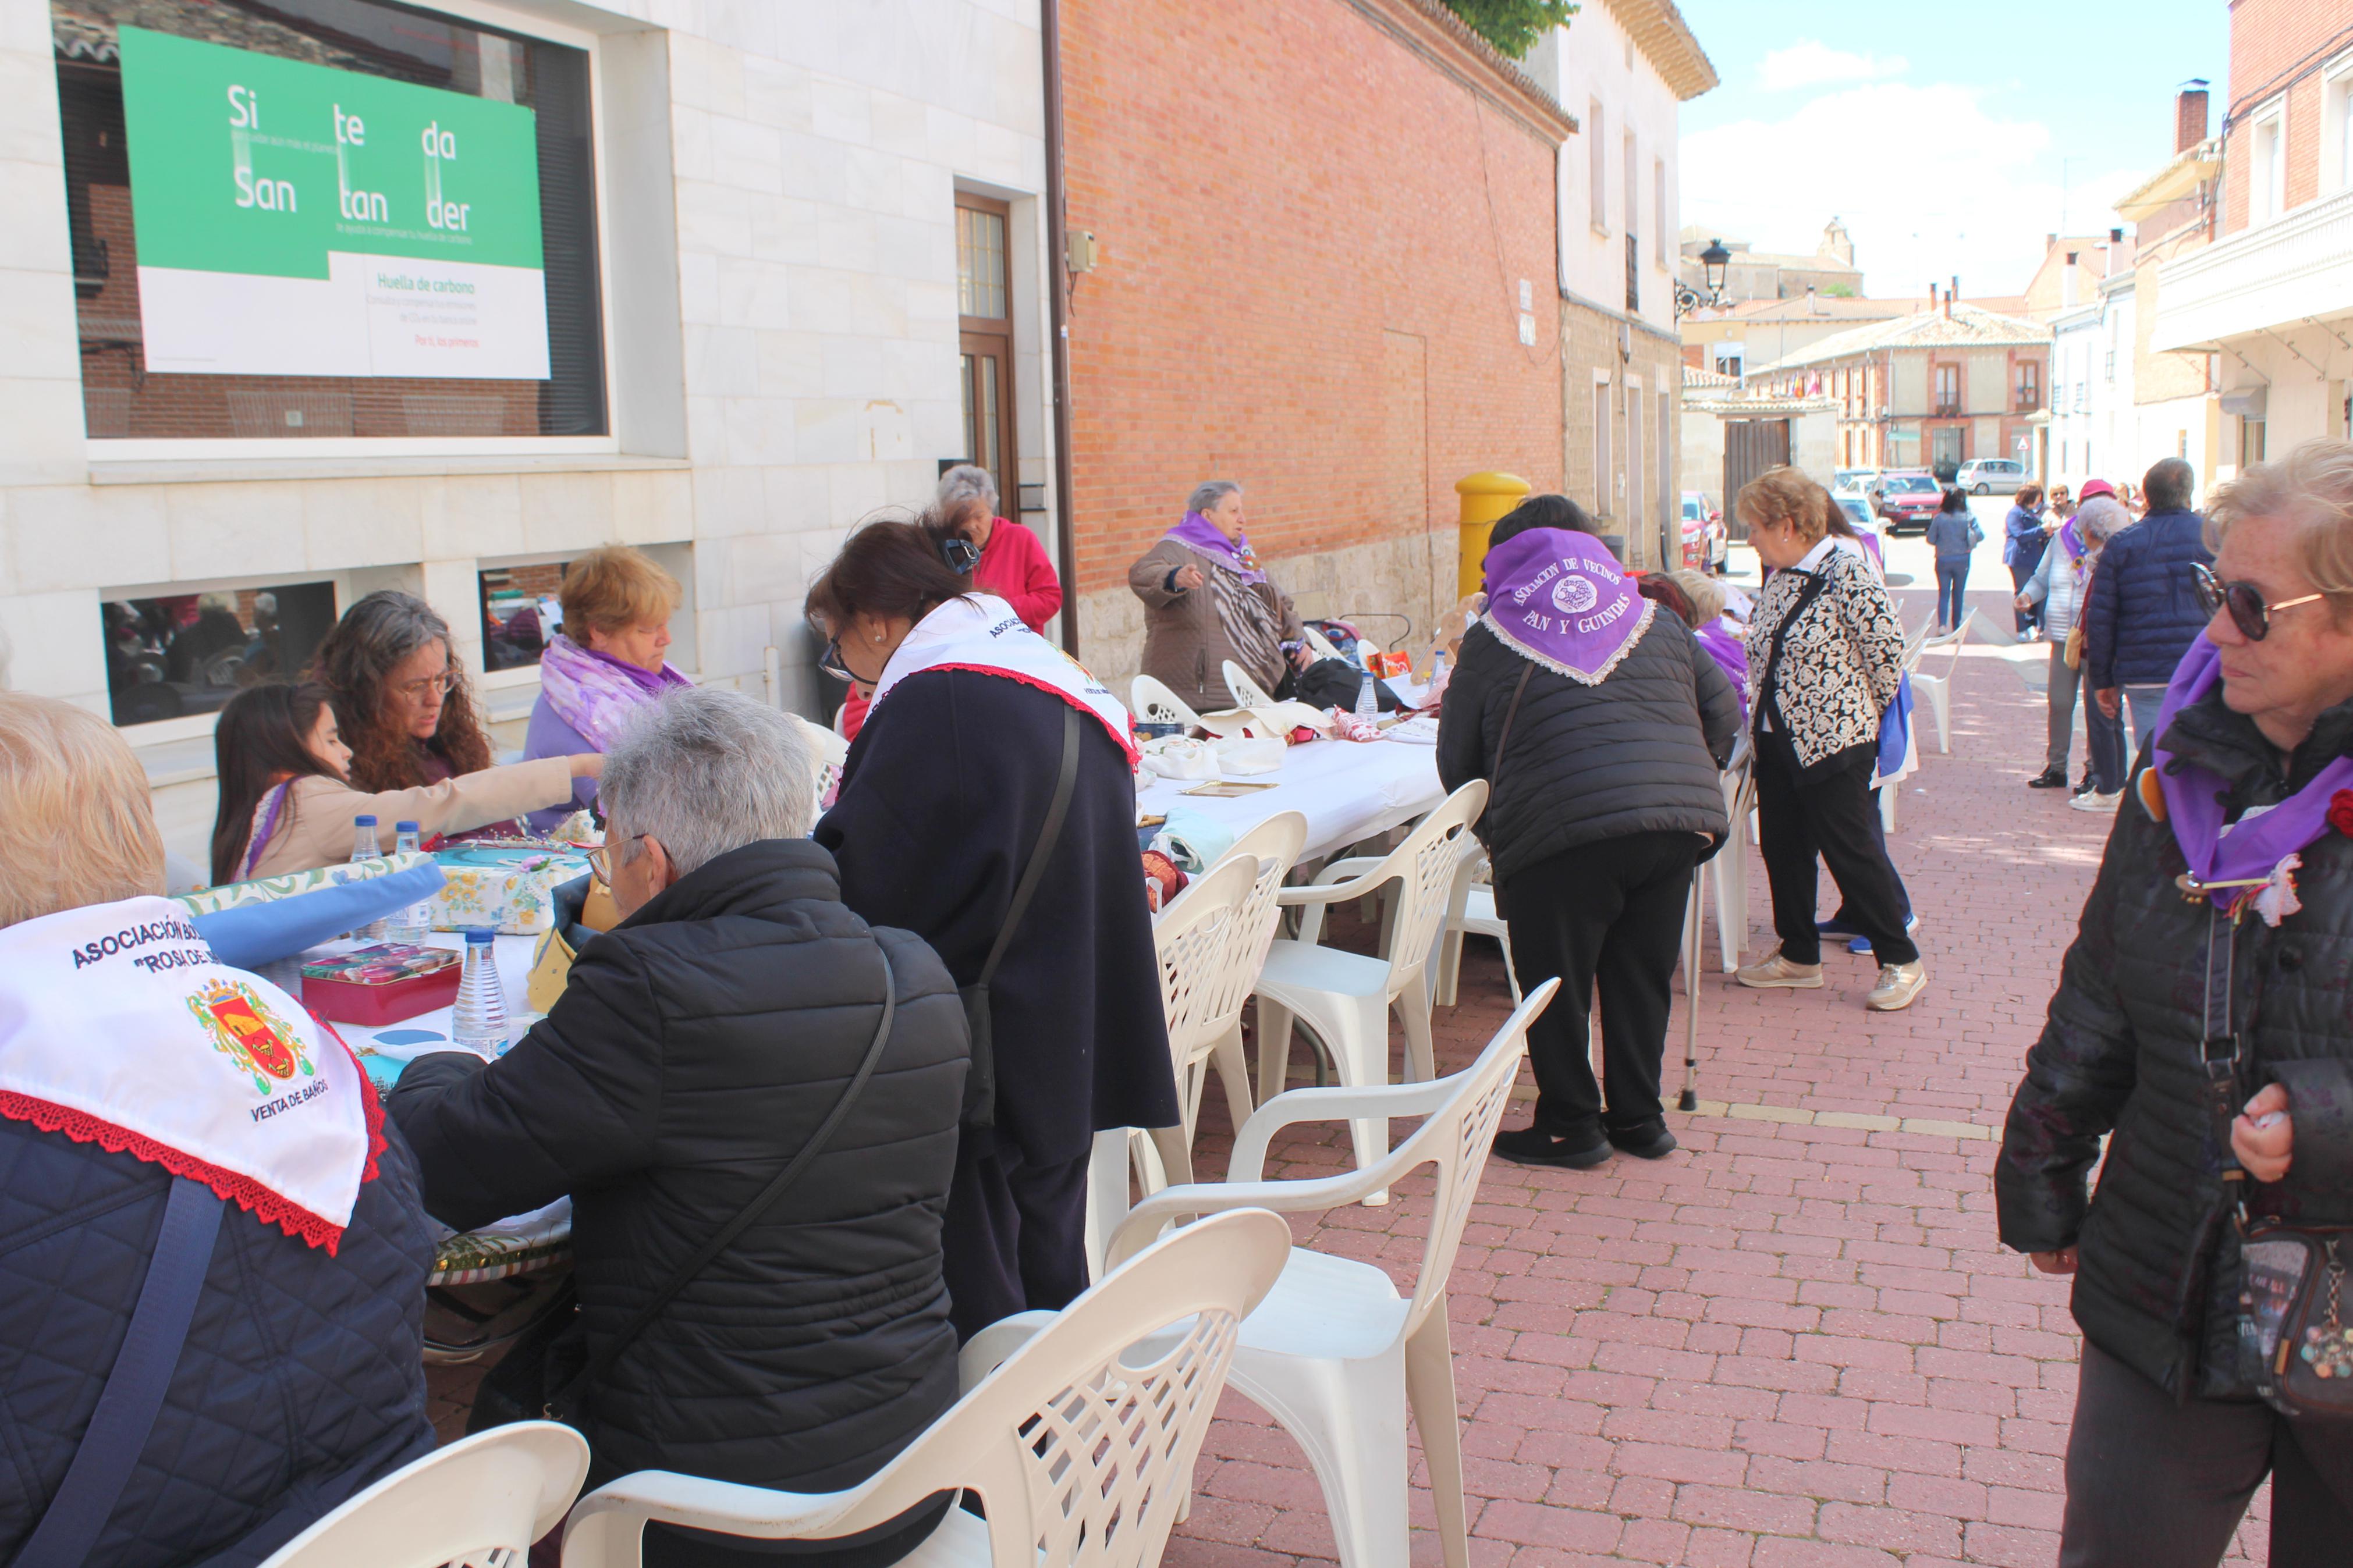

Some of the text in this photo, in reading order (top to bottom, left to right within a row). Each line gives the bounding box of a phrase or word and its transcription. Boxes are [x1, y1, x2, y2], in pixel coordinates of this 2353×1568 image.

[228, 84, 456, 160] Si te da
[234, 165, 470, 232] San tan der
[377, 272, 475, 294] Huella de carbono
[1513, 557, 1622, 607] ASOCIACION DE VECINOS
[1522, 592, 1630, 635] PAN Y GUINDAS
[73, 914, 183, 969] ASOCIACIÓN
[186, 950, 208, 966] DE
[251, 1079, 328, 1122] VENTA DE BAÑOS
